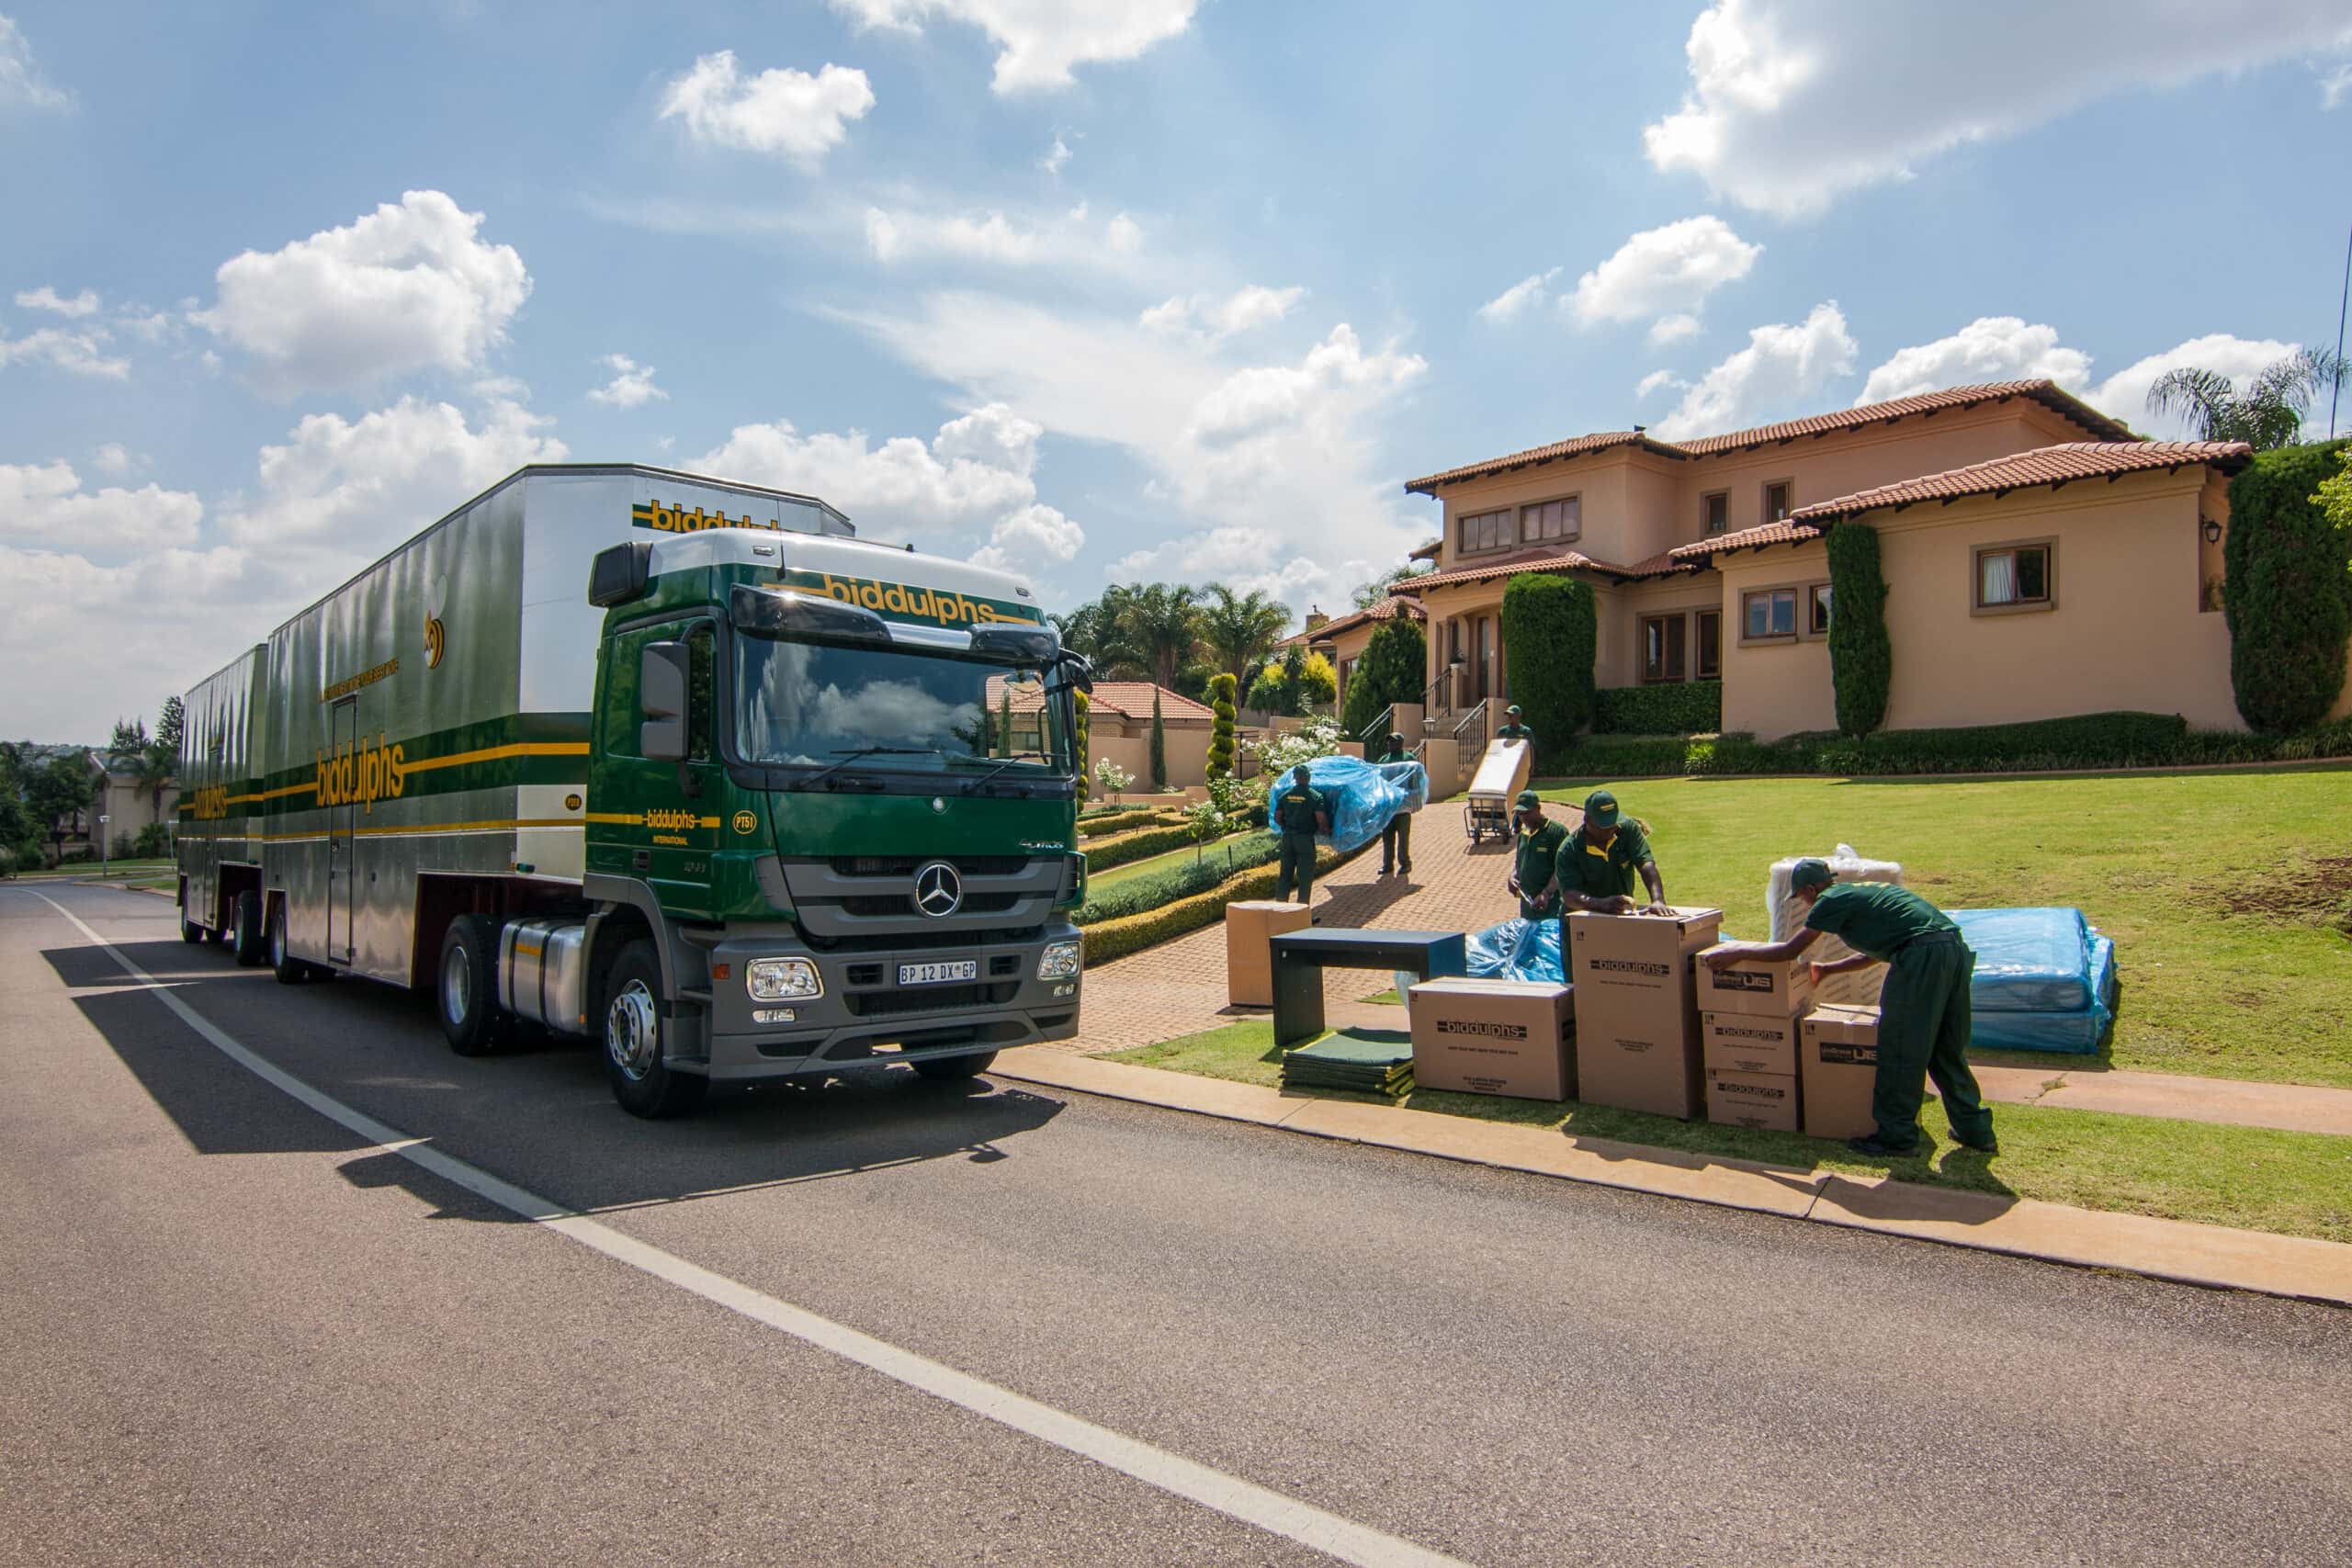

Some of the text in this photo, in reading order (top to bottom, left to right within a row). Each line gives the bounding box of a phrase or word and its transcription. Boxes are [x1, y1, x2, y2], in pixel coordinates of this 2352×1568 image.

[823, 574, 995, 625] biddulphs
[317, 733, 404, 816] biddulphs
[647, 808, 696, 832] biddulphs
[736, 816, 753, 829] PT51
[901, 963, 975, 983] BP 12 DX GP
[1447, 1019, 1520, 1038] biddulphs
